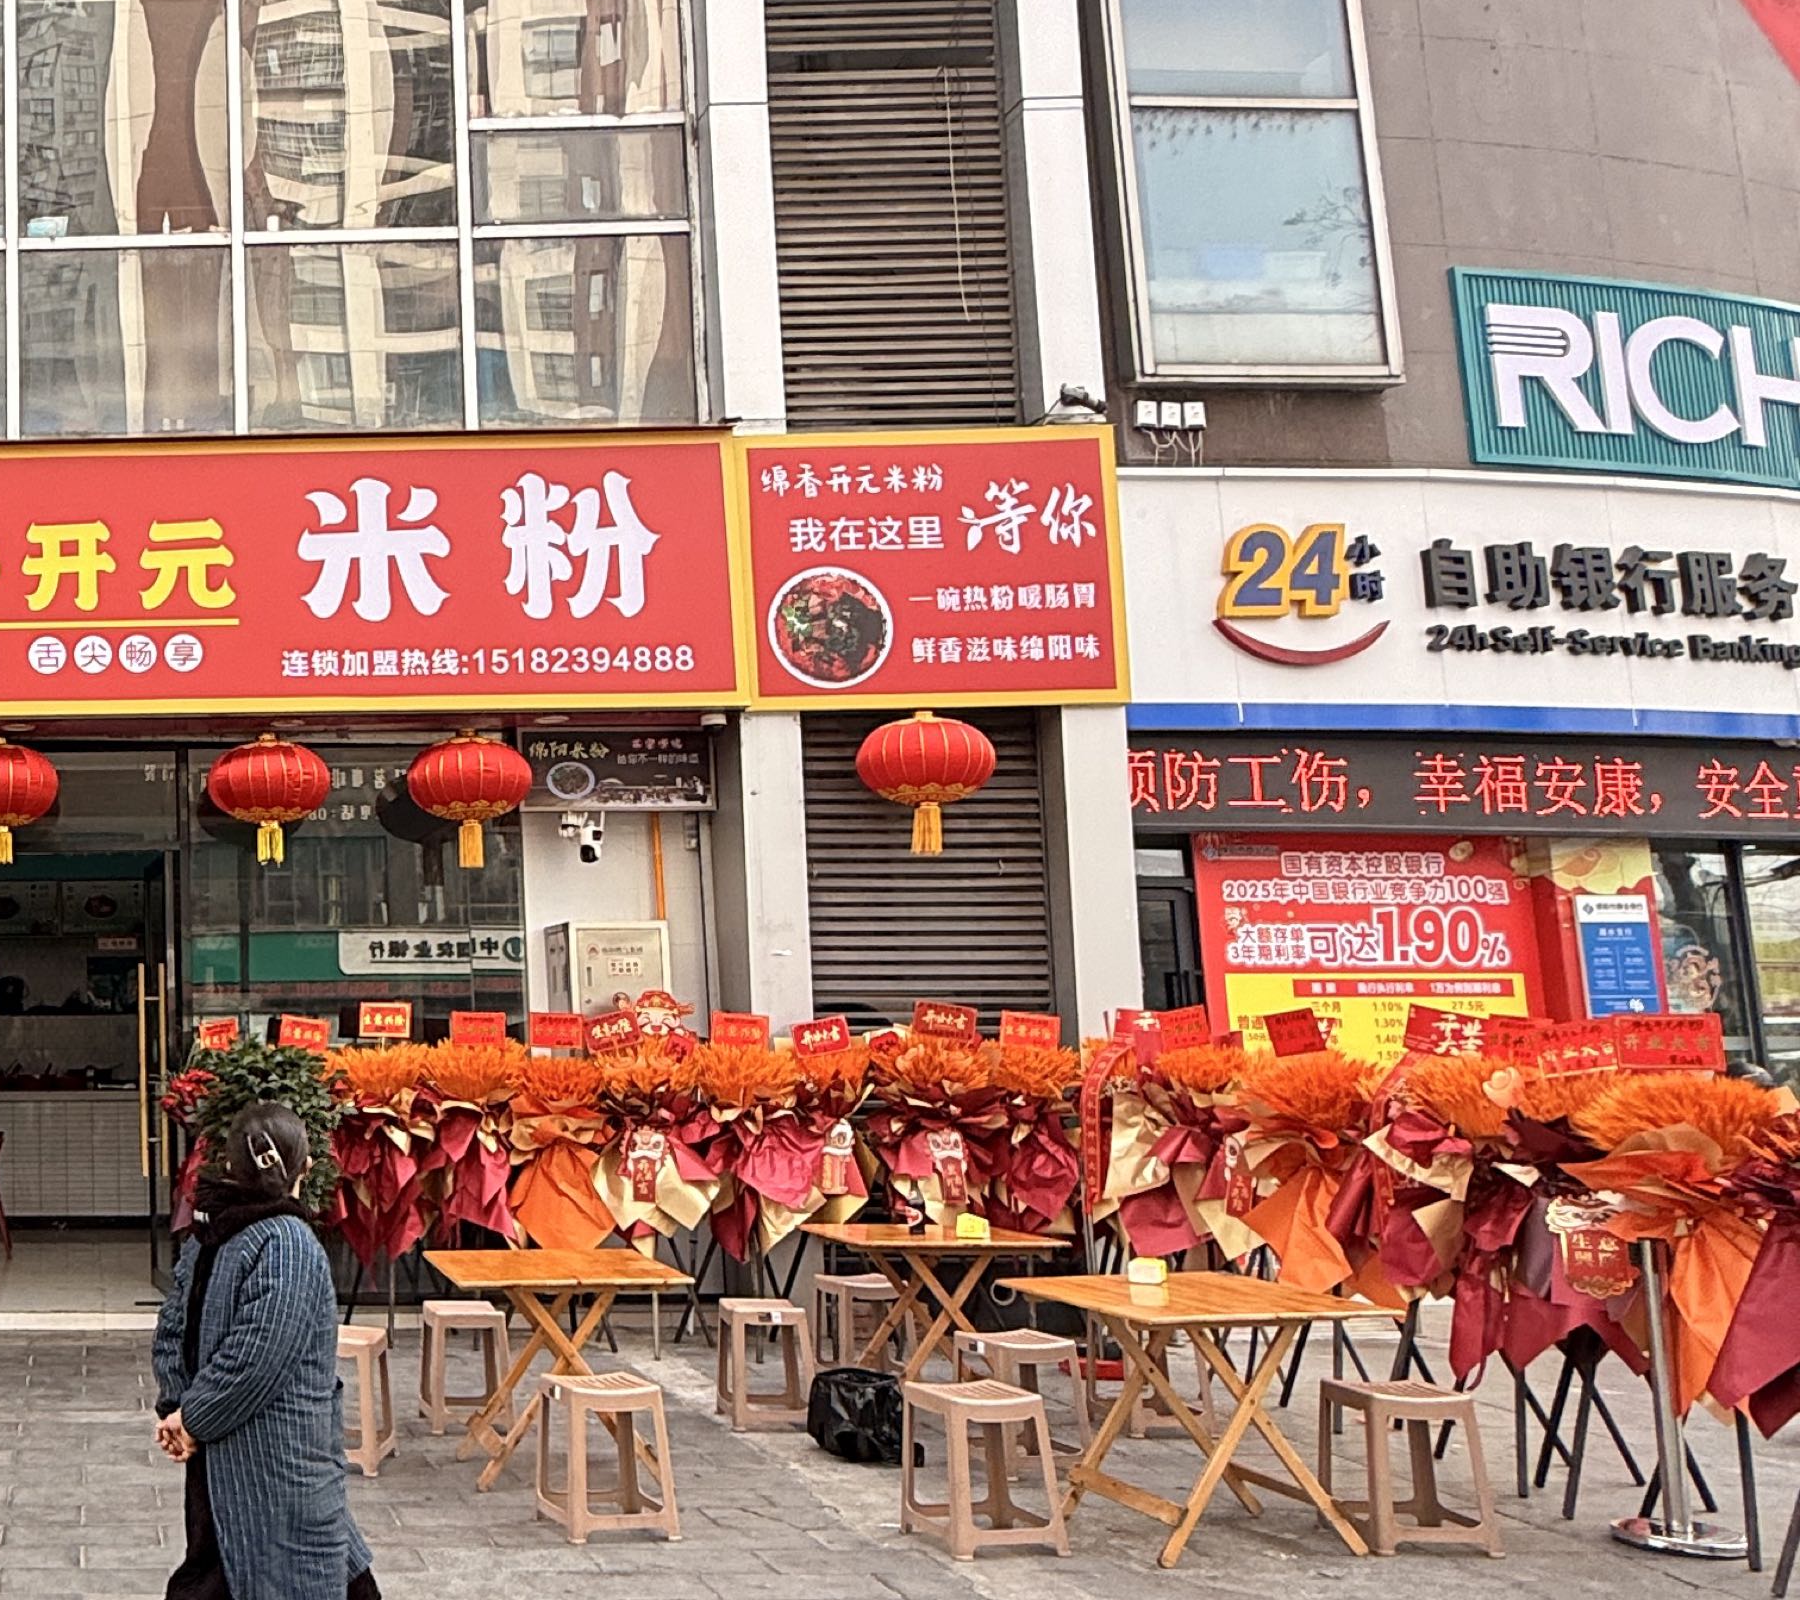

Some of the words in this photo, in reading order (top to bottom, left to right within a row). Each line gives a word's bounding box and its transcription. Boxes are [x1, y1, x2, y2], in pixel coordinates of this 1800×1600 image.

[760, 463, 943, 498] 绵香开元米粉
[788, 515, 945, 553] 我在这里
[957, 477, 1097, 555] 等你
[296, 469, 661, 623] 米粉
[1218, 523, 1350, 619] 24
[1419, 537, 1799, 622] 自助银行服务
[908, 581, 1096, 612] 一碗热粉暖肠胃
[29, 633, 201, 672] 舌尖畅享
[281, 644, 695, 679] 连锁加盟热线:15182394888
[911, 633, 1101, 664] 鲜香滋味绵阳味
[1282, 853, 1445, 876] 国有资本控股银行
[1224, 876, 1509, 904] 2025年中国银行业竞争力100强
